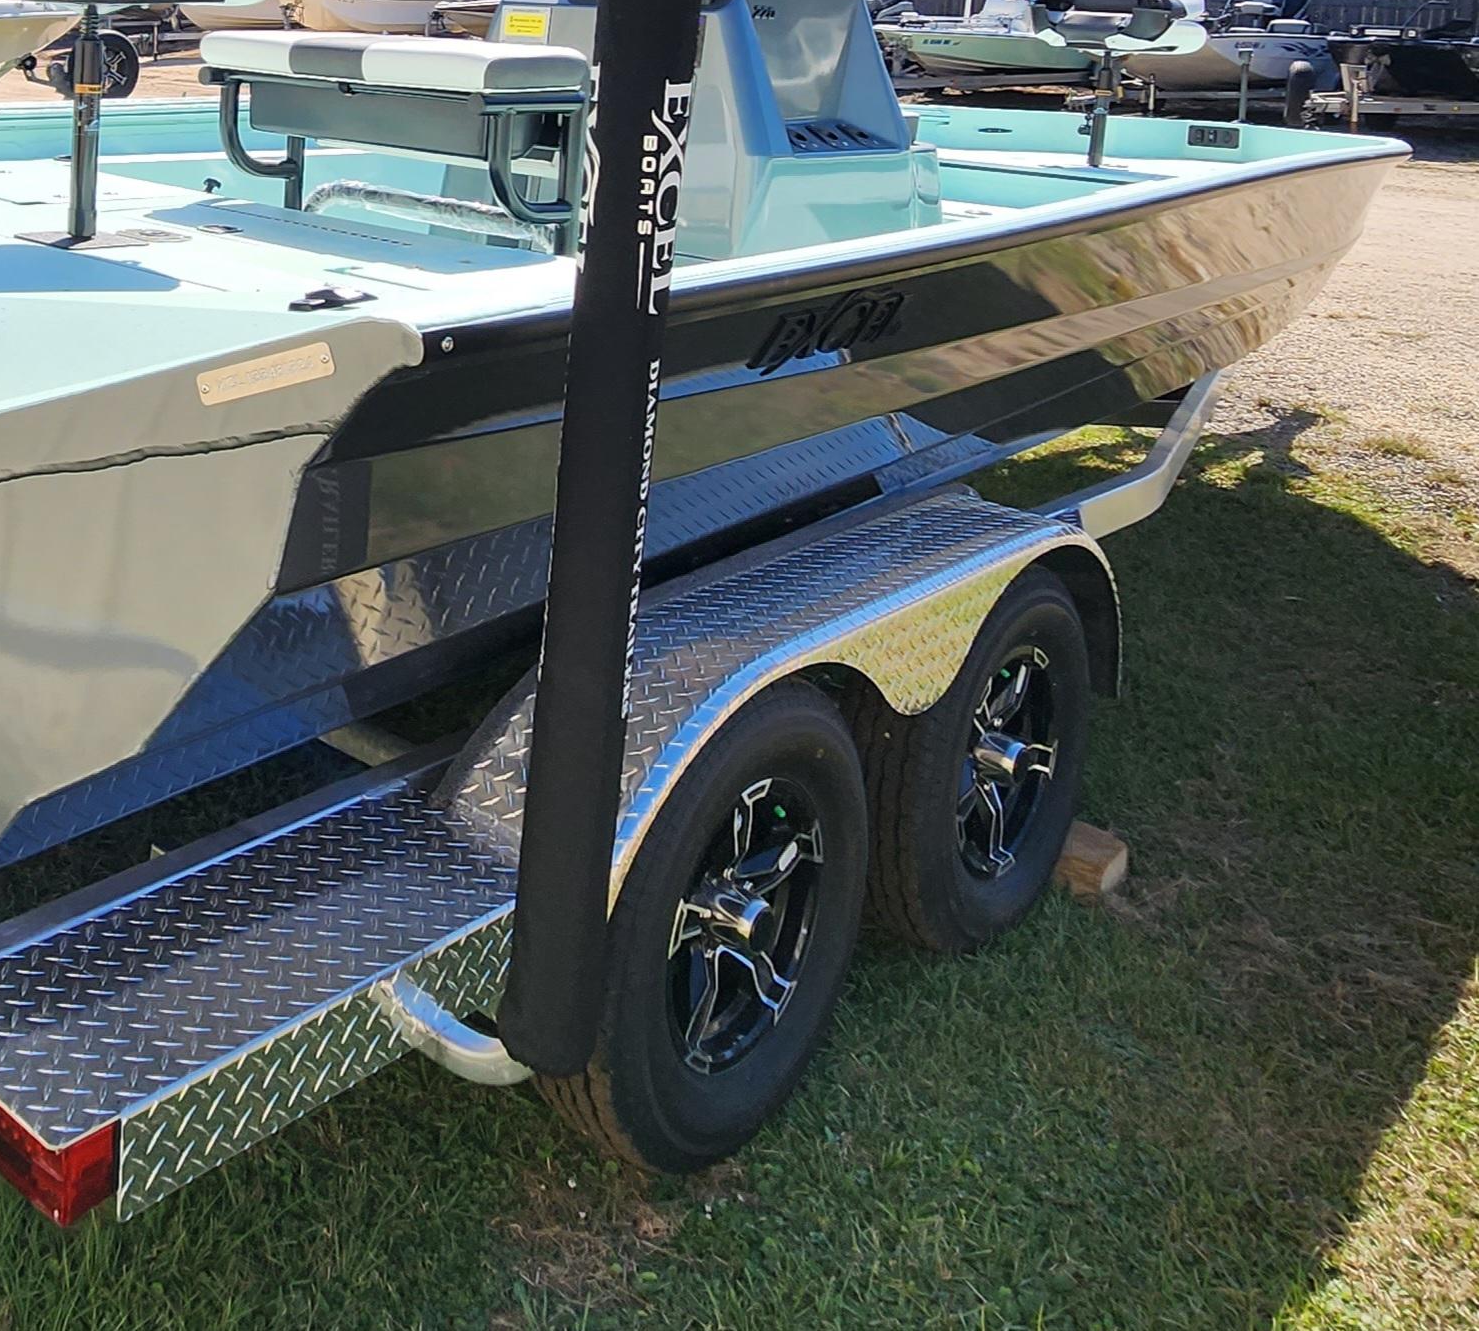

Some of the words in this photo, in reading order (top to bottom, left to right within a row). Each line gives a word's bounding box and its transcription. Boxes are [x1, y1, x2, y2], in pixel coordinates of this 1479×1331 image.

[637, 134, 659, 236] BOATS
[648, 78, 693, 315] EXCEL
[639, 358, 661, 501] DIAMOND
[633, 506, 647, 574] CITY
